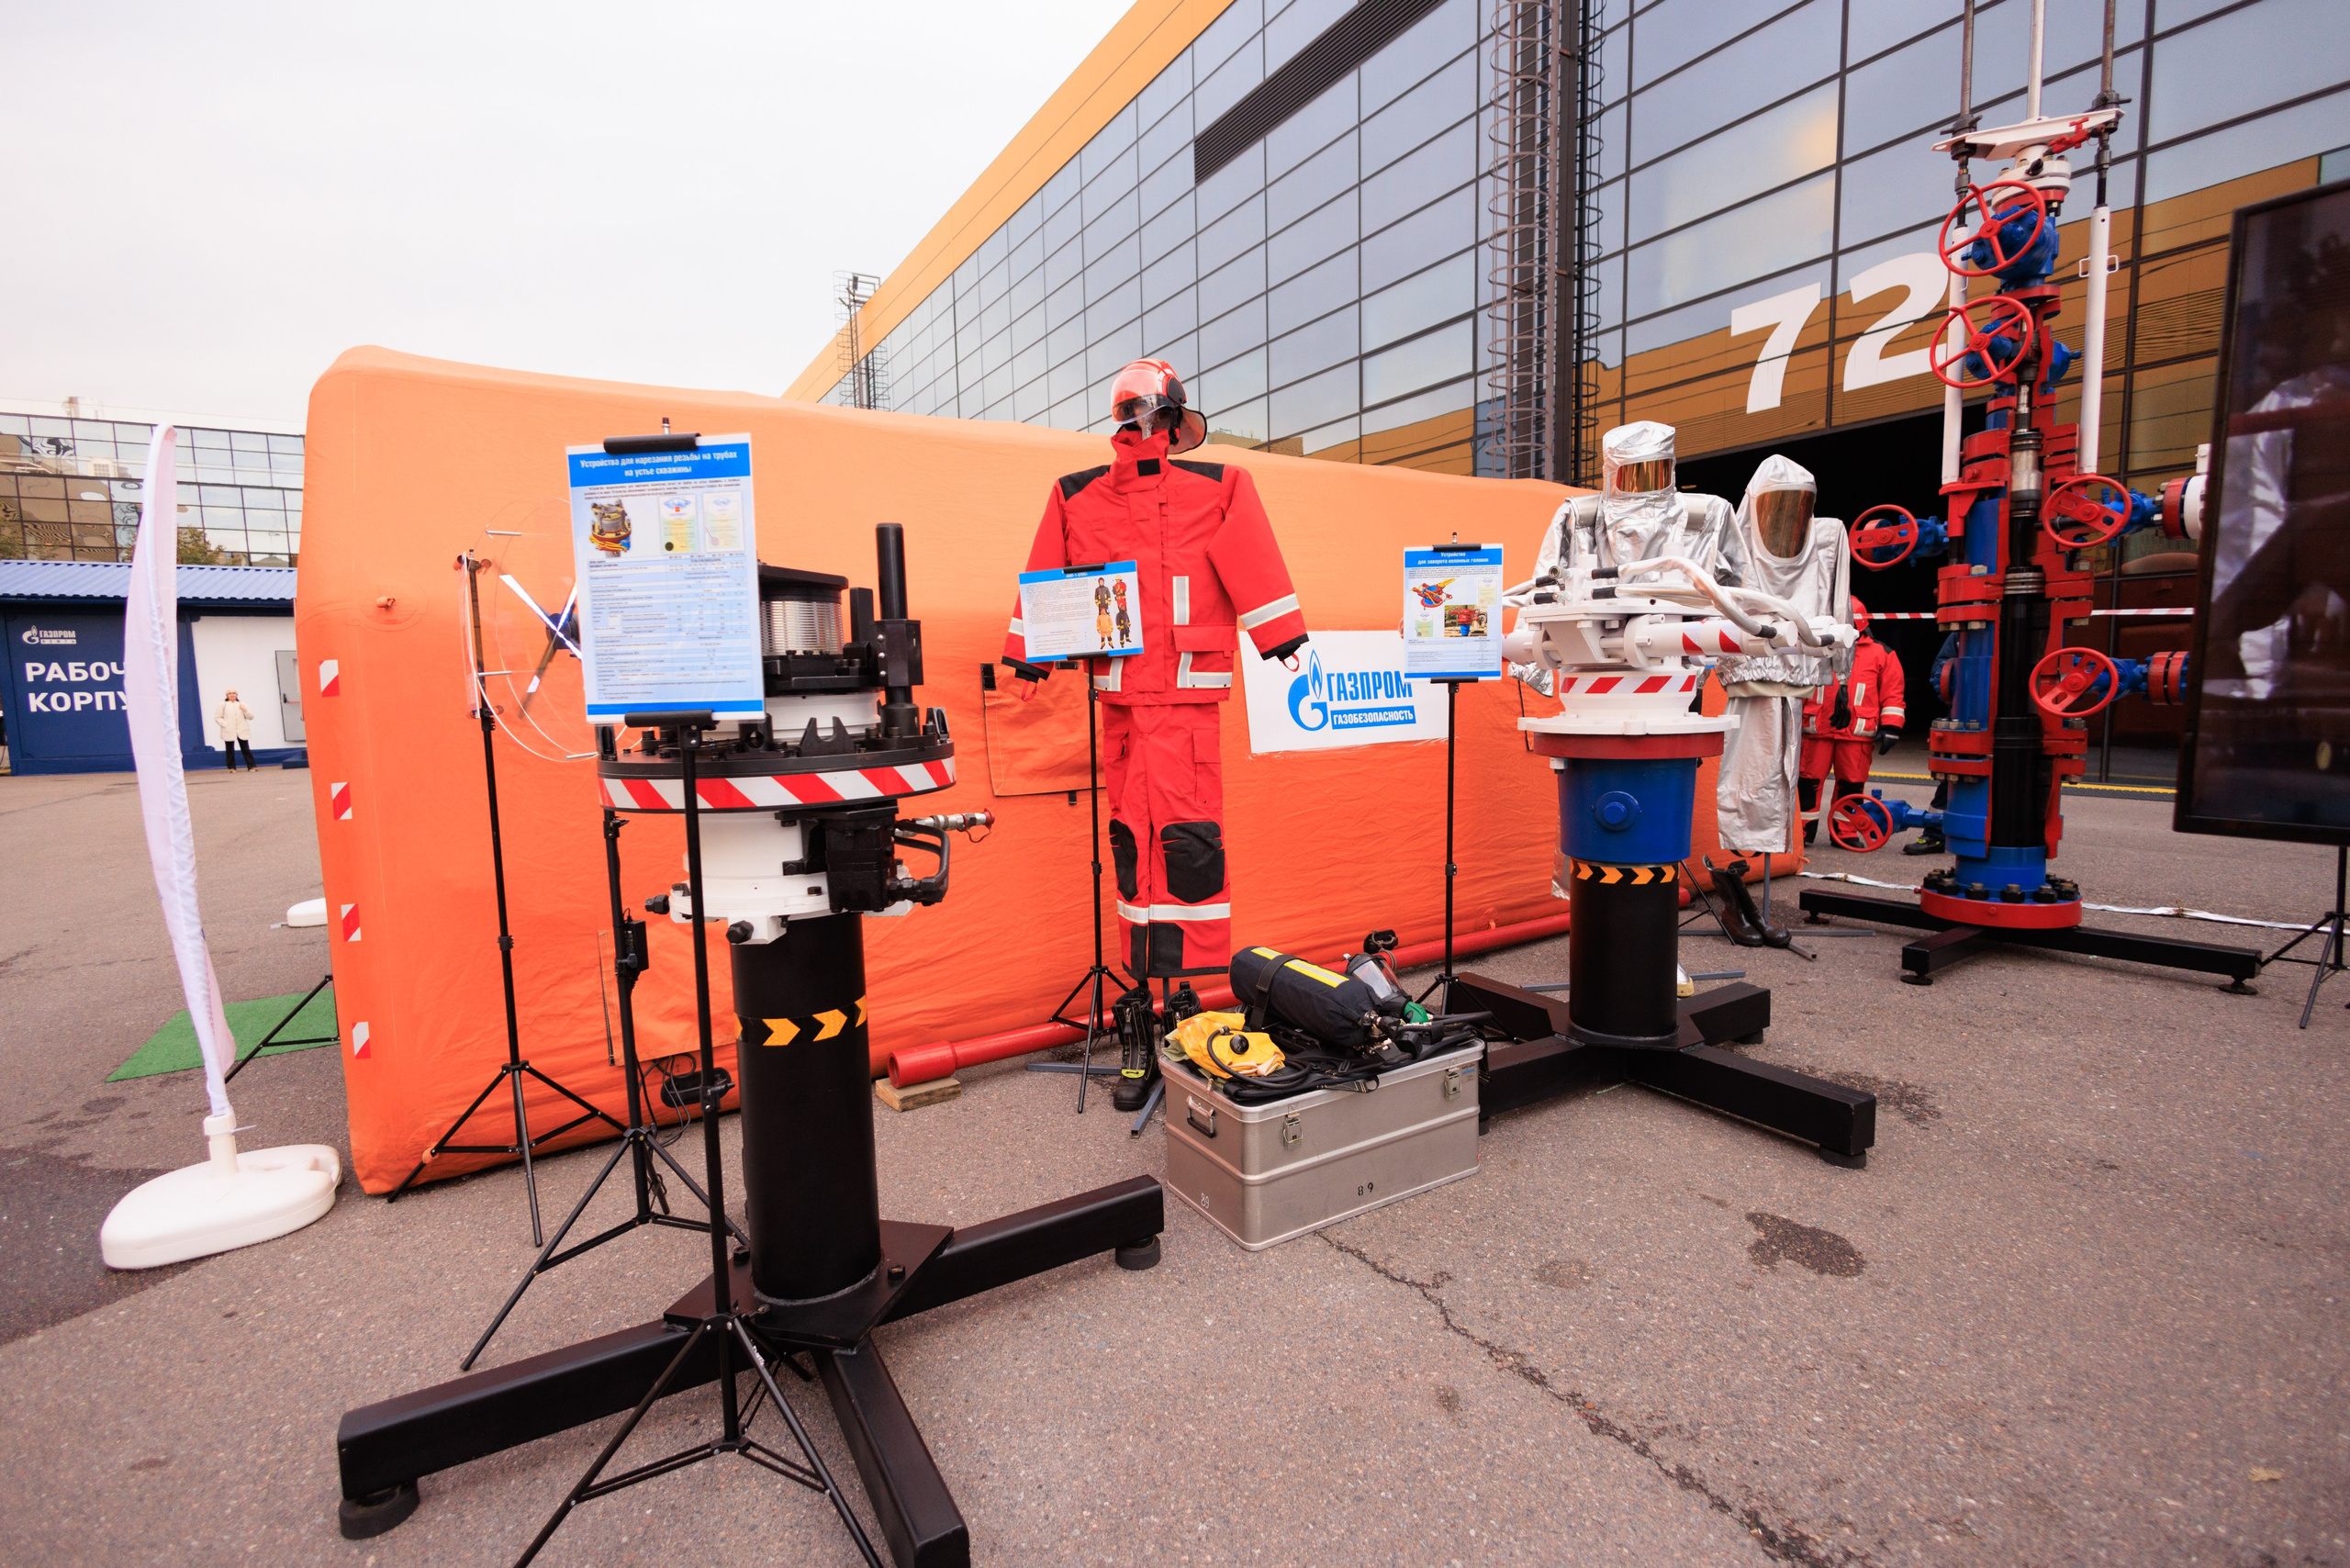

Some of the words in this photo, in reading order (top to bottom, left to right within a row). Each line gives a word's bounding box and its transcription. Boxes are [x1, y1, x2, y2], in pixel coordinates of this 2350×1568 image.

[1730, 252, 1949, 414] 72
[580, 459, 620, 469] Устройства
[621, 458, 634, 466] для
[635, 455, 673, 465] нарезания
[674, 453, 700, 464] резьбы
[712, 451, 737, 461] трубах
[634, 467, 655, 477] устье
[655, 465, 692, 476] скважины
[39, 630, 76, 638] ГАЗПРОМ
[1326, 671, 1413, 701] ГАЗПРОМ
[1333, 710, 1414, 725] ГАЗОБЕЗОПАСНОСТЬ
